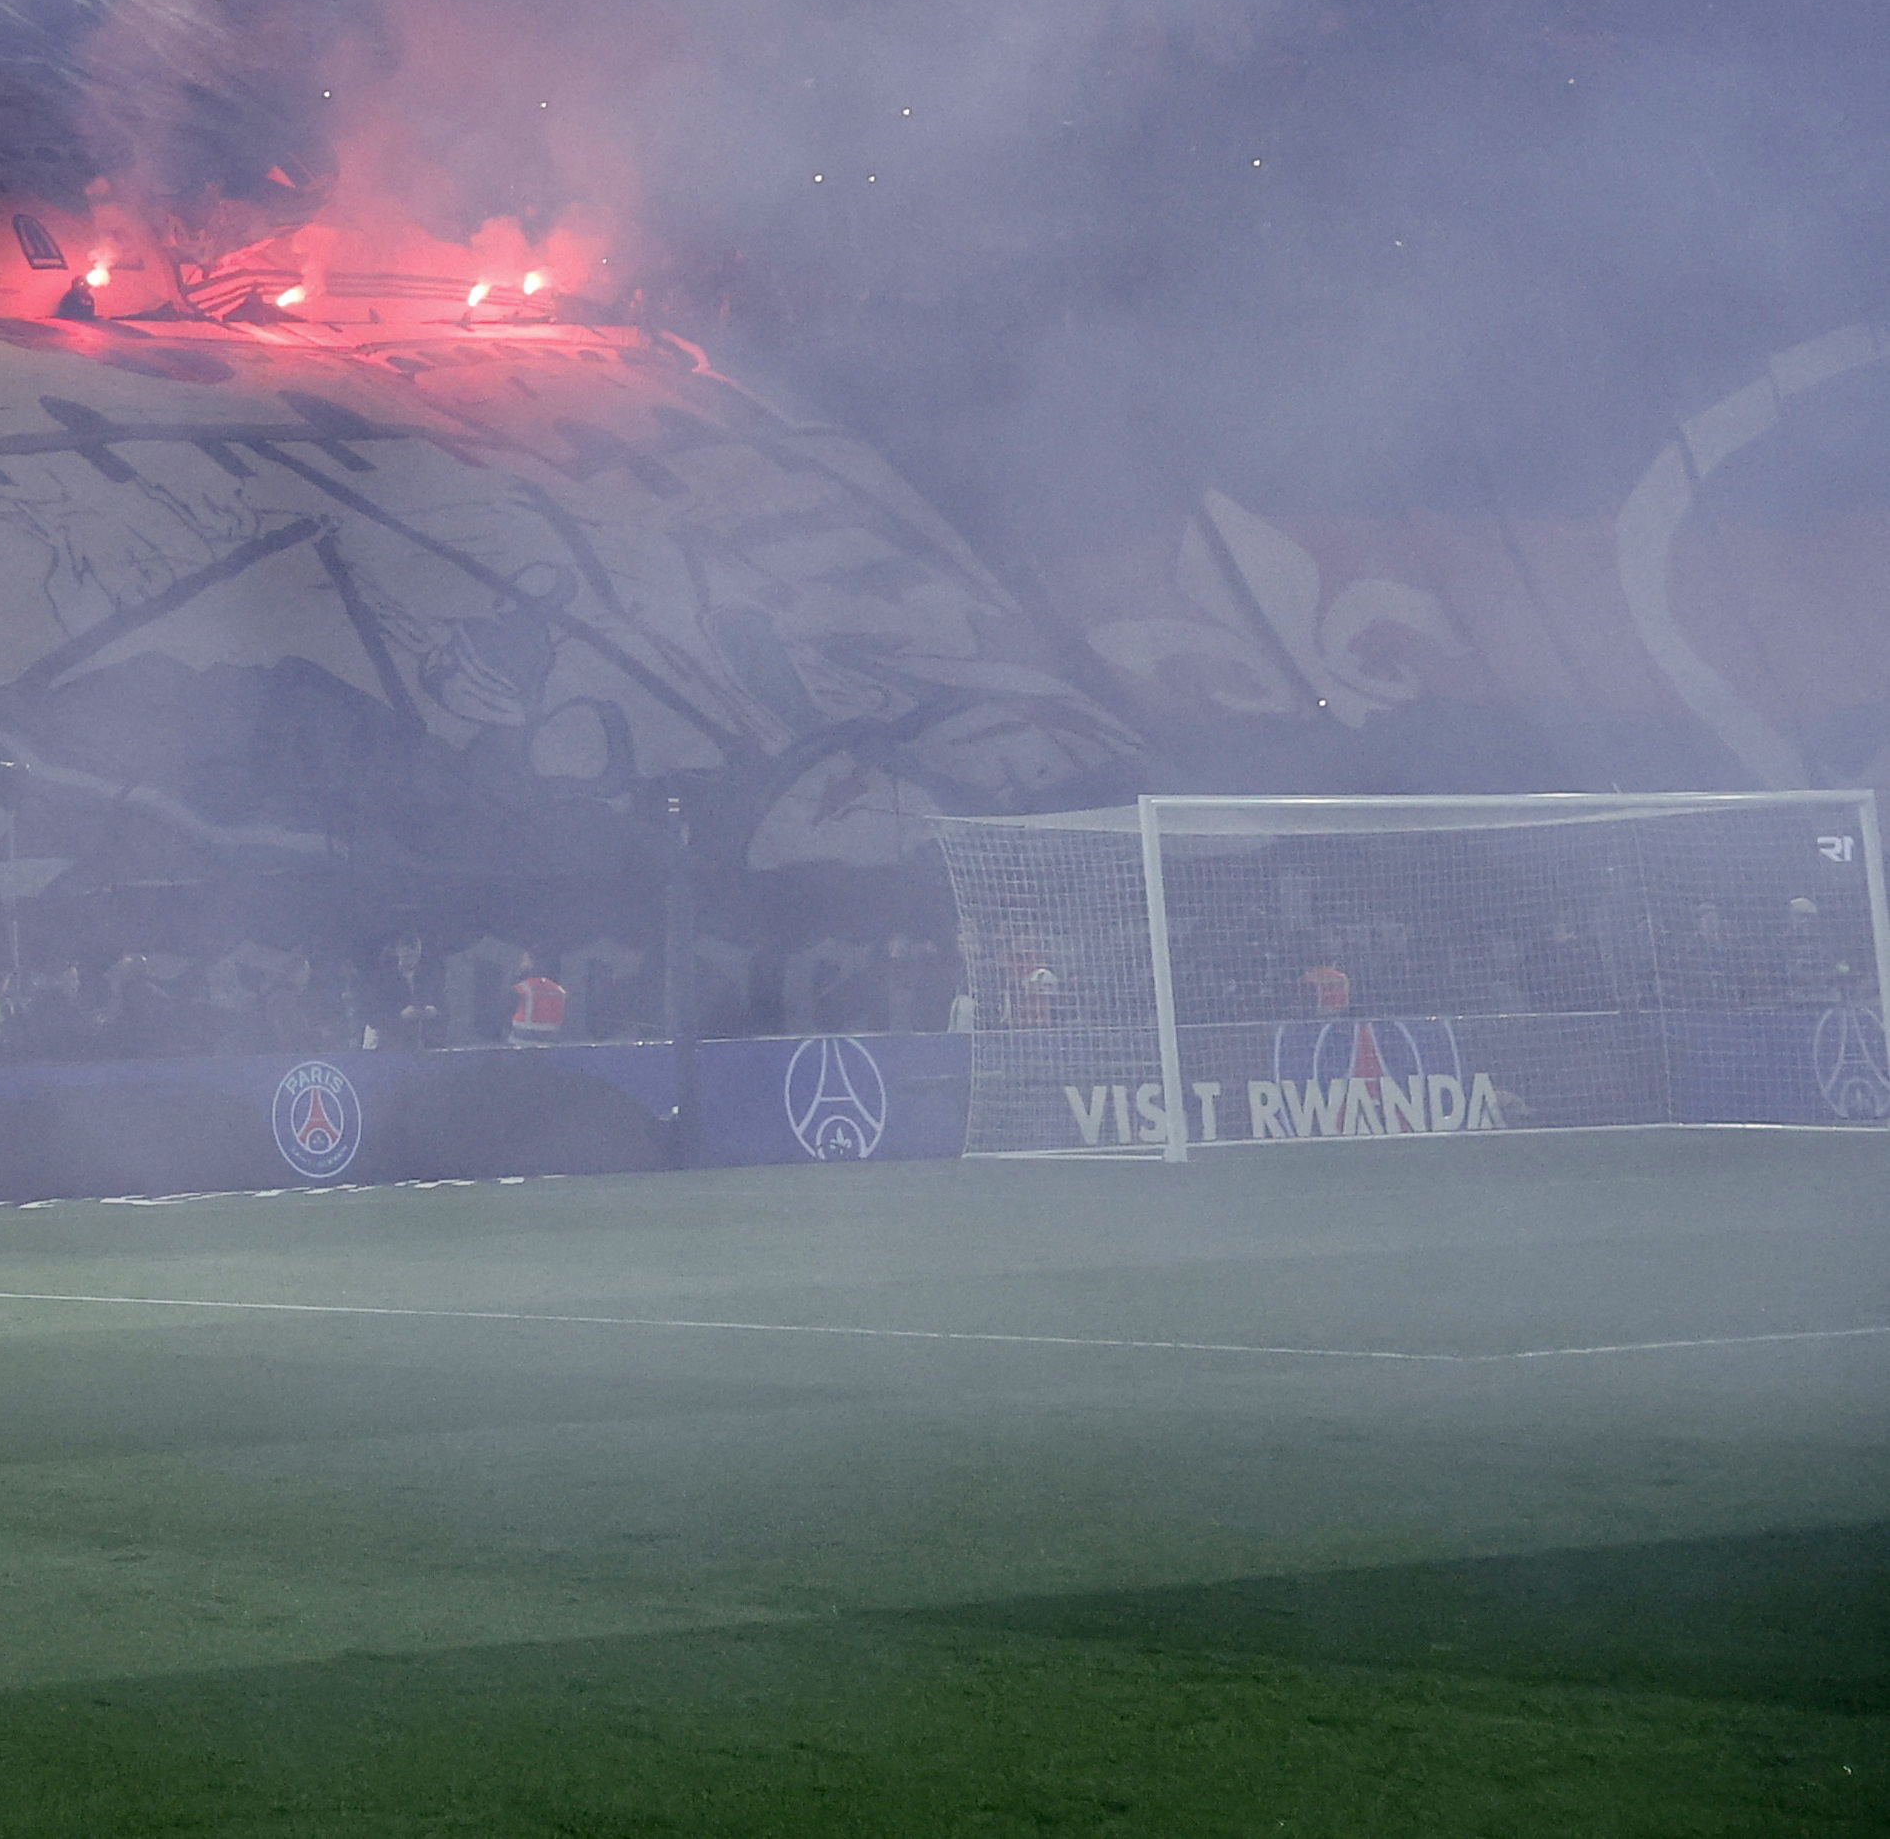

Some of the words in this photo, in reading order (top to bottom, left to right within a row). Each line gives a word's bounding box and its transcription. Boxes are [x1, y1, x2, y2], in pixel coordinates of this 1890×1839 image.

[285, 1066, 344, 1096] PARIS
[1064, 1080, 1221, 1145] VIST
[1247, 1072, 1508, 1140] RWANDA
